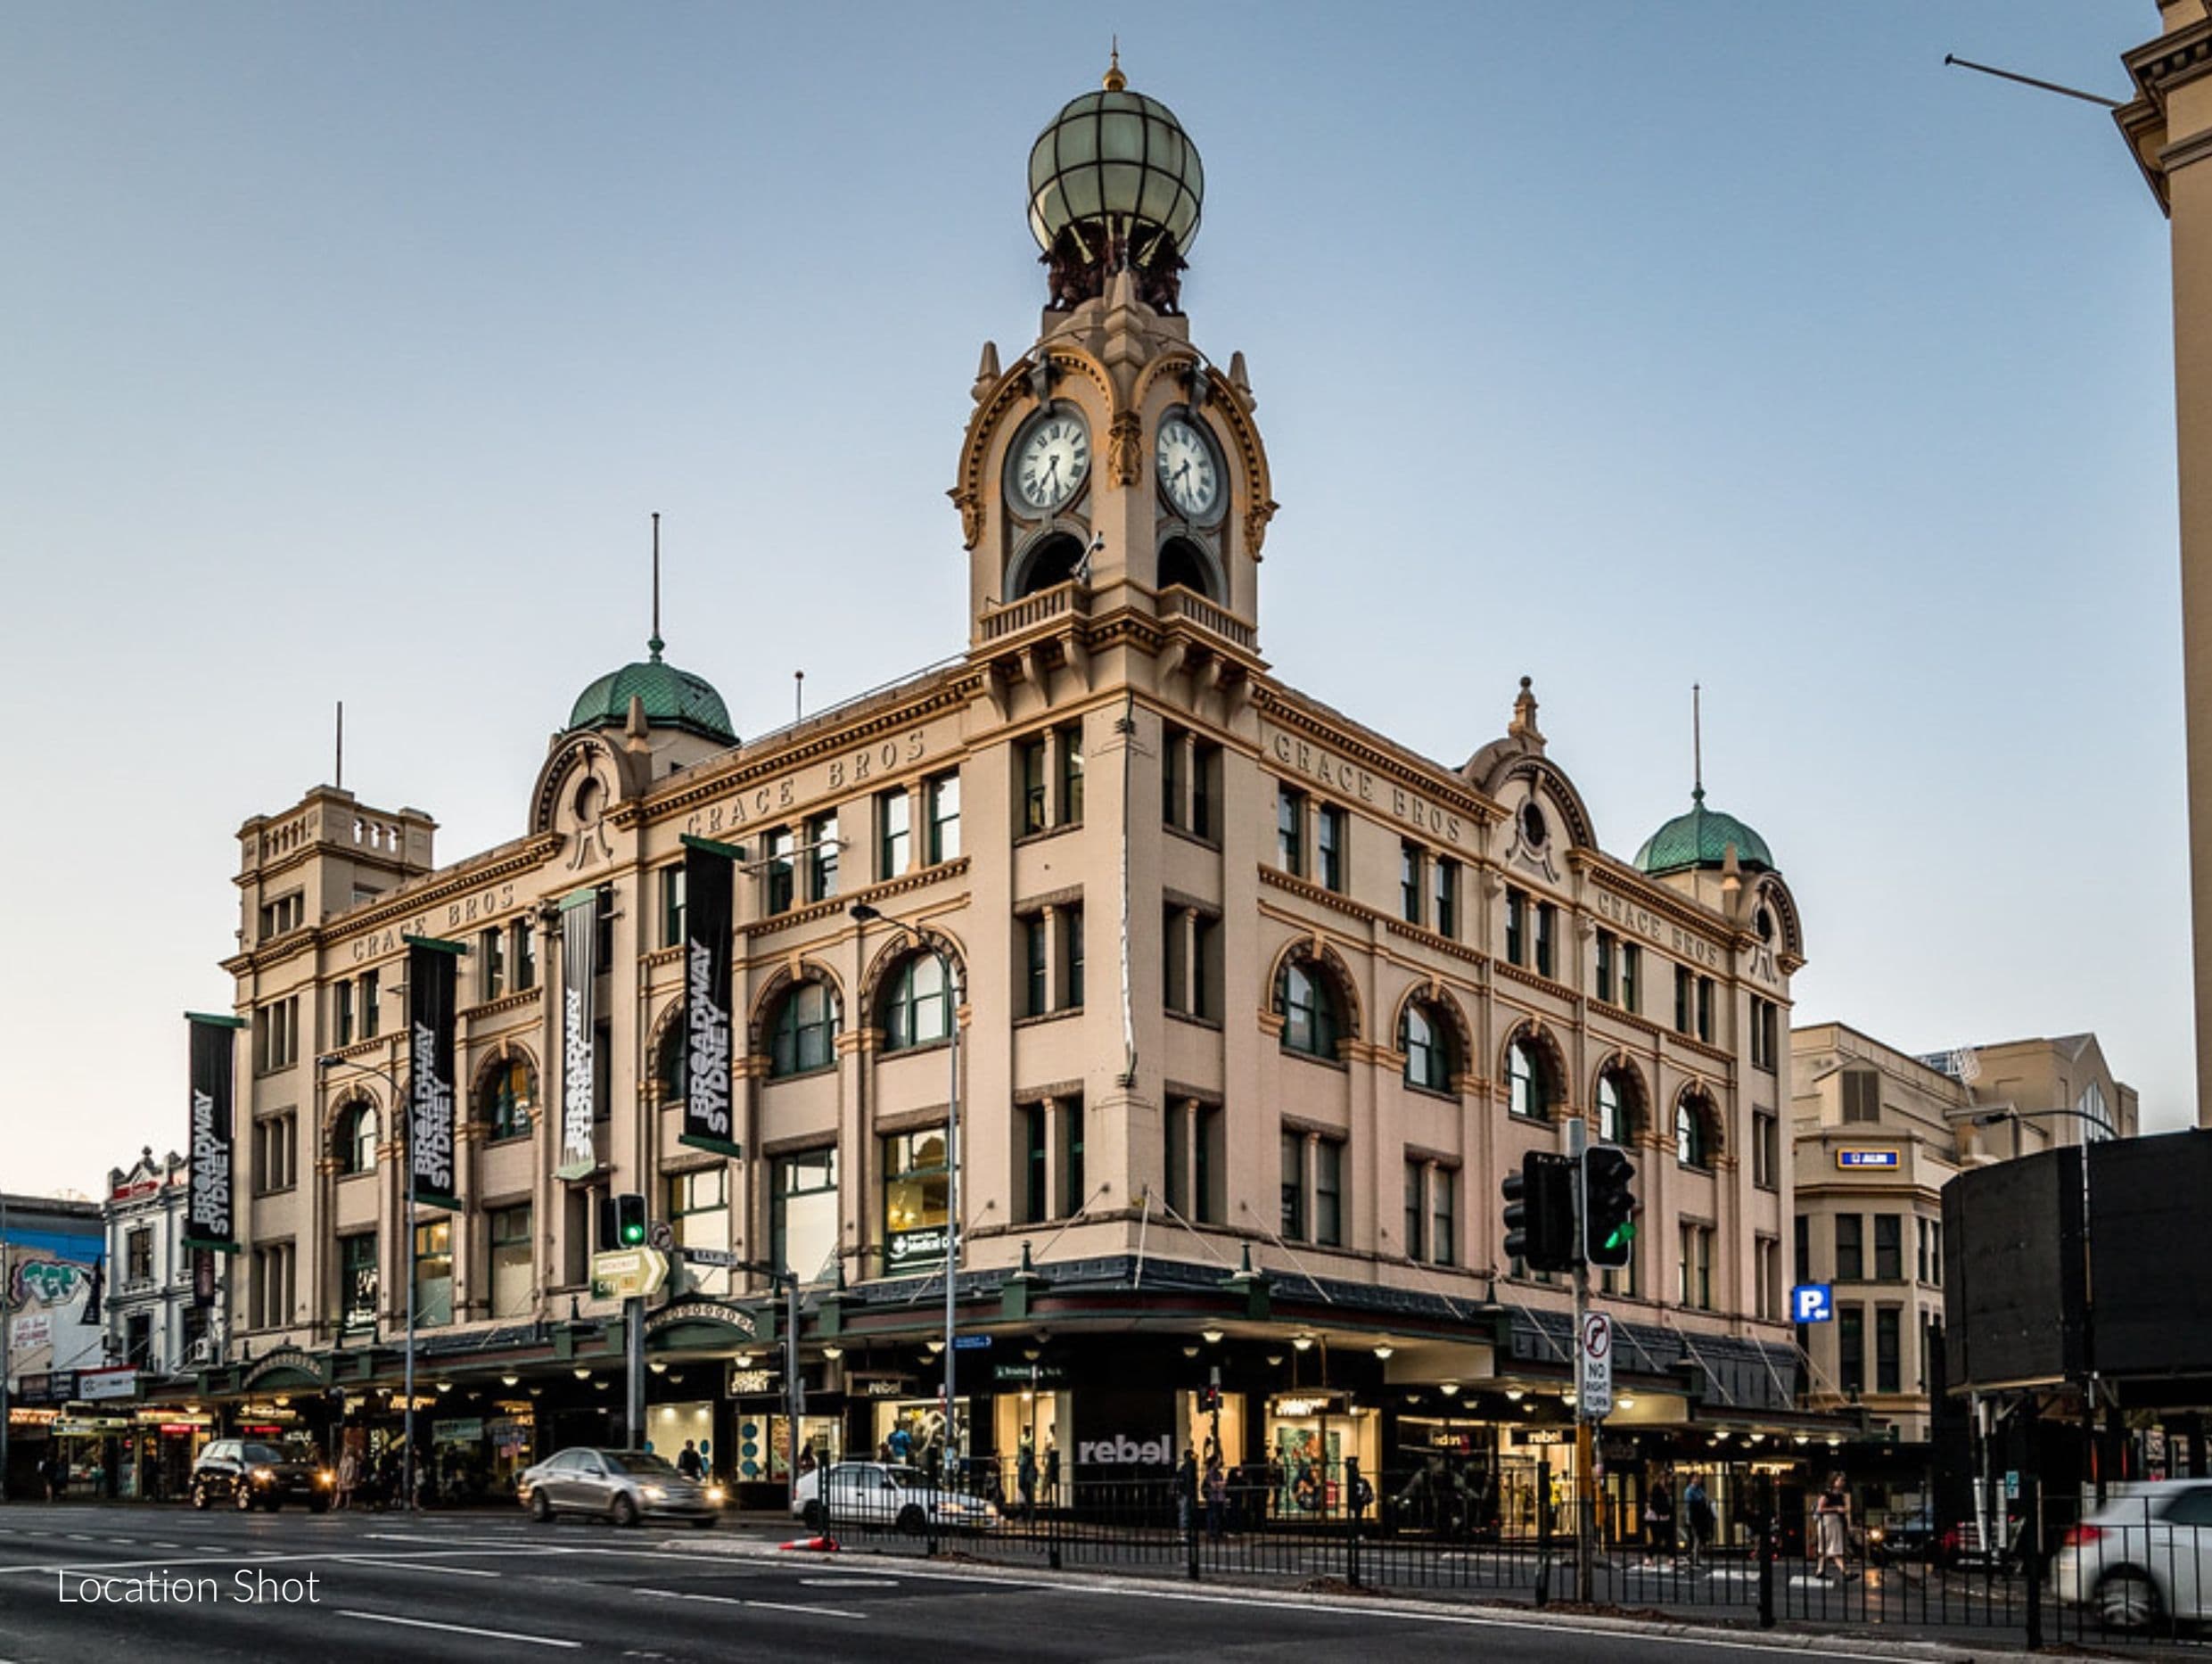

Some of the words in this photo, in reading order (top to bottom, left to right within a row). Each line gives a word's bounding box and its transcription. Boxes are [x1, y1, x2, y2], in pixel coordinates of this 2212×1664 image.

[687, 780, 794, 836] GRACE
[827, 730, 925, 790] BROS
[1273, 733, 1374, 803] GRACE
[1393, 788, 1461, 843] BROS
[353, 917, 426, 962] GRACE
[448, 885, 514, 928] BROS
[1598, 892, 1661, 942] GRACE
[1671, 927, 1718, 968] BROS
[690, 935, 711, 1118] BROADWAY
[707, 1001, 728, 1134] SYDNEY
[415, 1020, 435, 1176] BROADWAY
[432, 1075, 450, 1190] SYDNEY
[193, 1089, 214, 1225] BROADWAY
[209, 1140, 228, 1235] SYDNEY
[1799, 1289, 1823, 1318] P
[1585, 1380, 1608, 1392] RIGHT
[1585, 1395, 1608, 1407] TURN
[1588, 1363, 1606, 1380] NO
[1079, 1434, 1171, 1464] rebel
